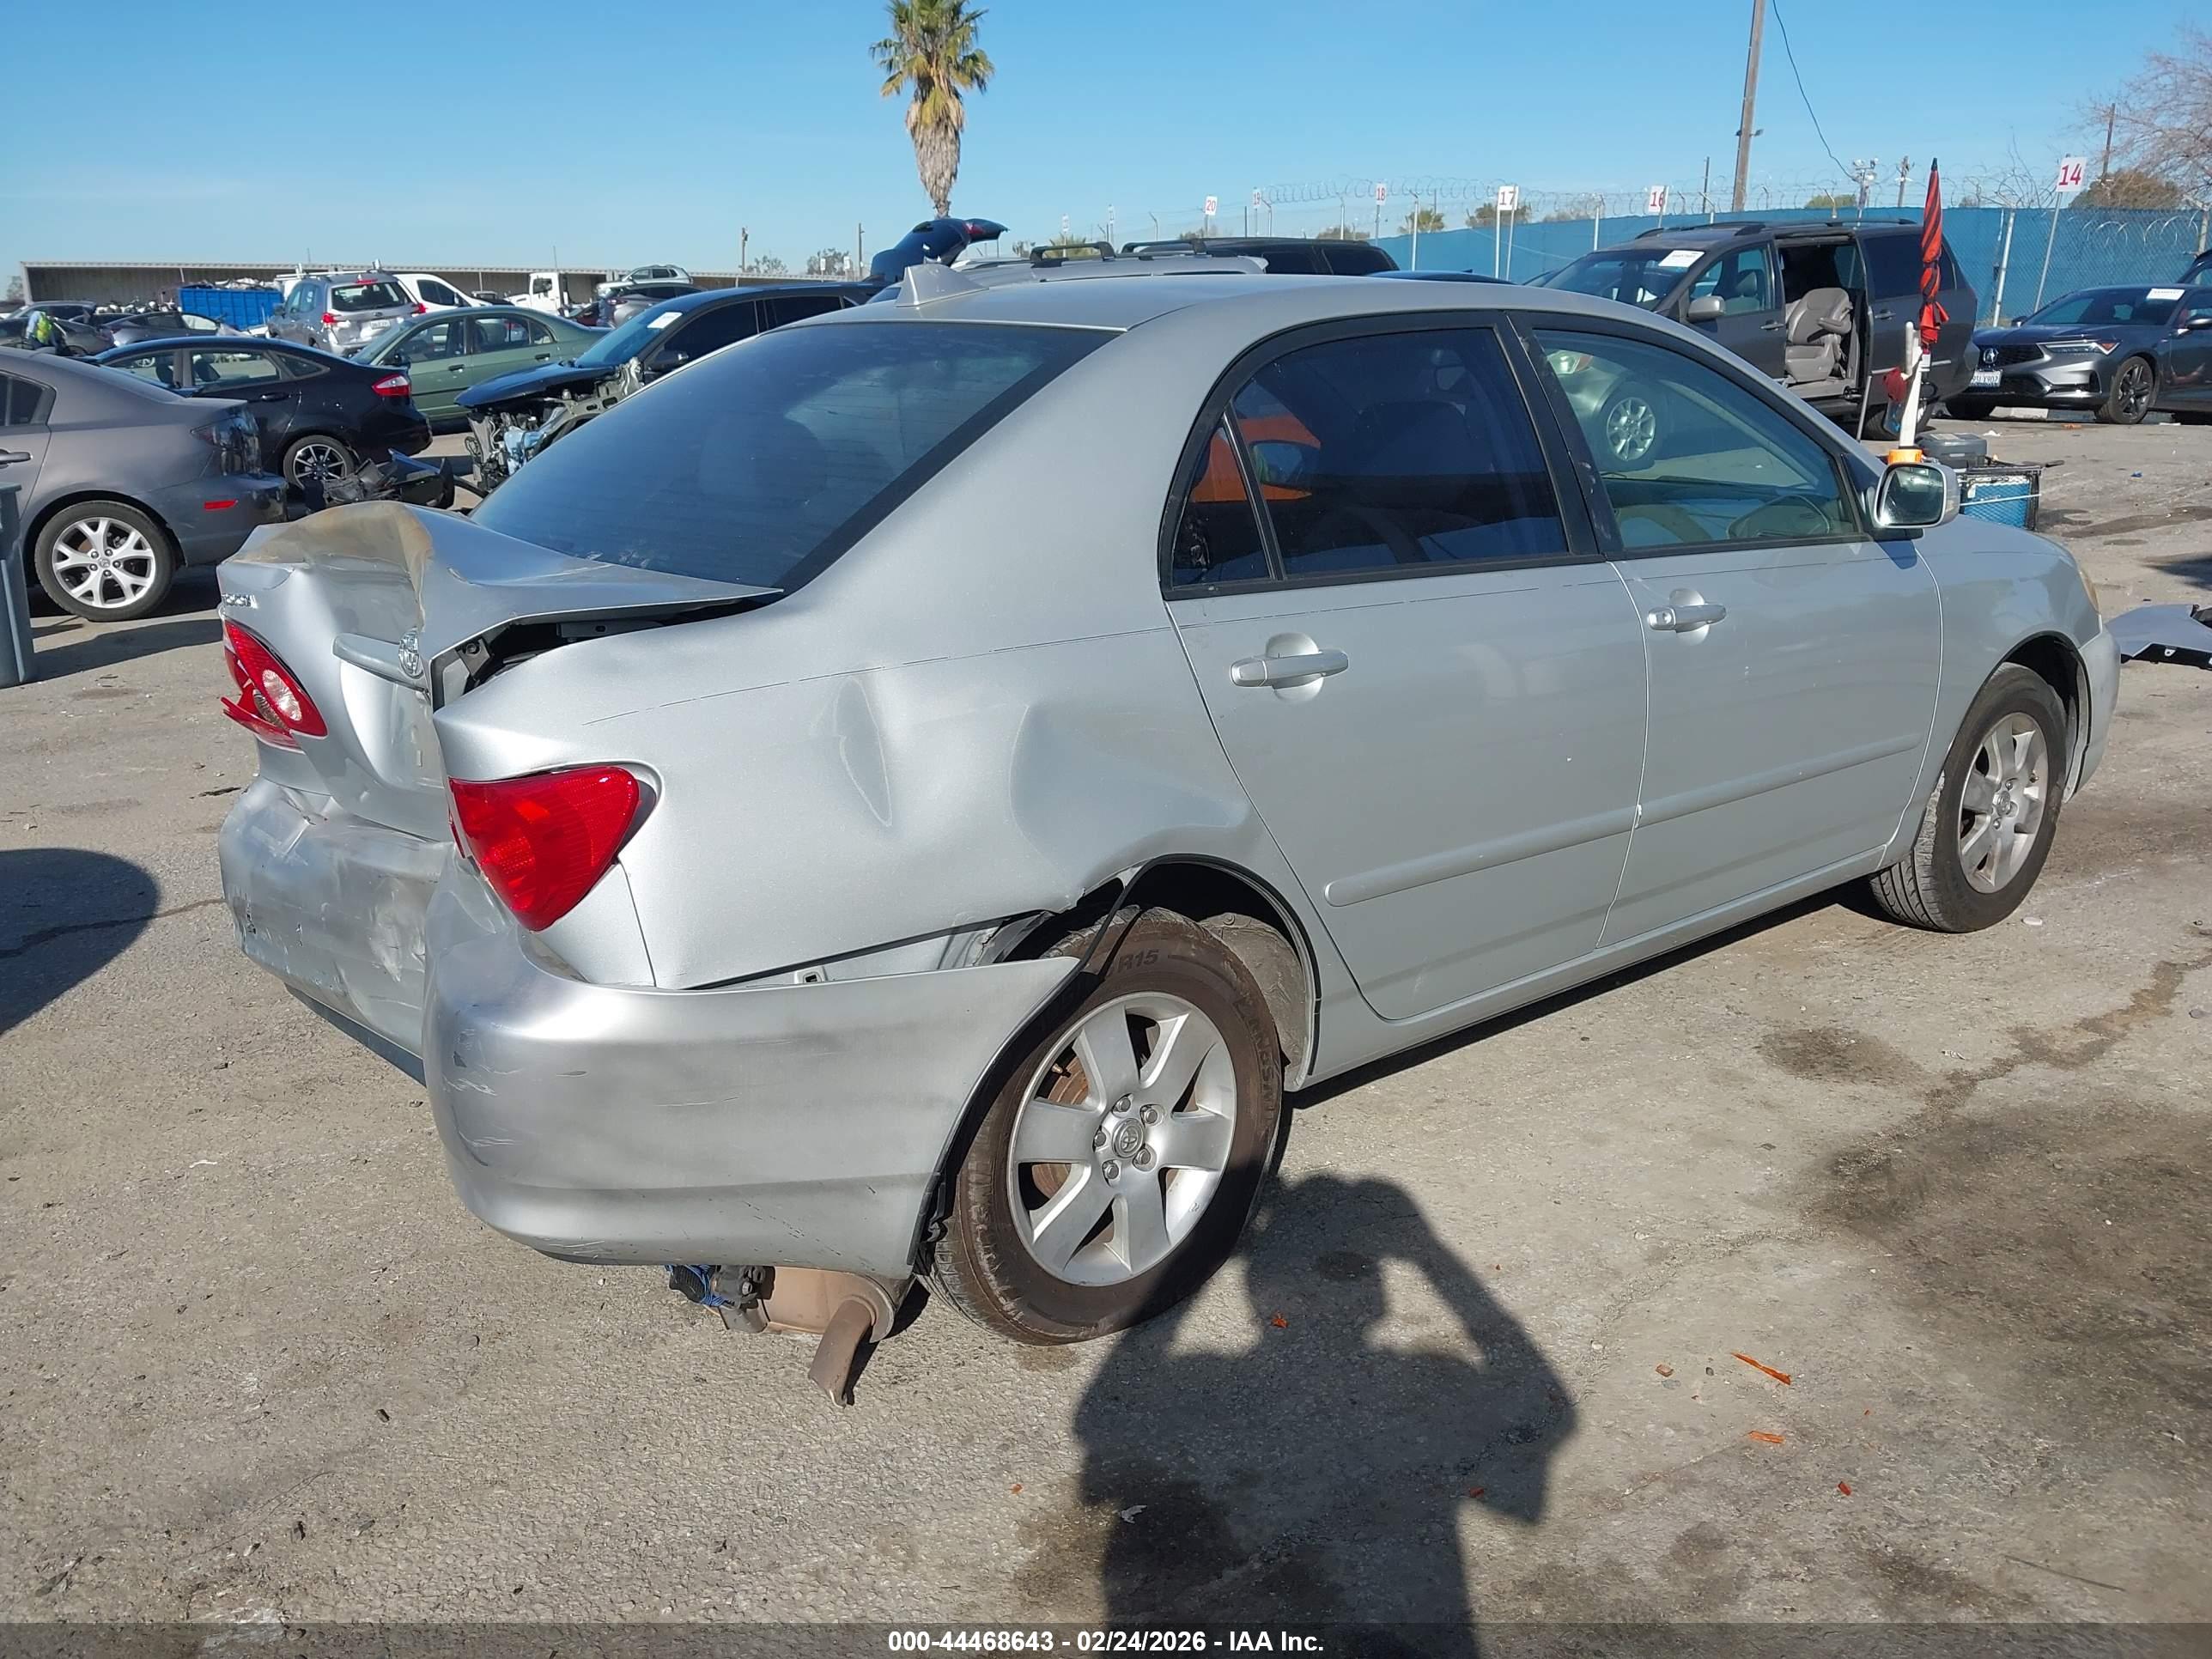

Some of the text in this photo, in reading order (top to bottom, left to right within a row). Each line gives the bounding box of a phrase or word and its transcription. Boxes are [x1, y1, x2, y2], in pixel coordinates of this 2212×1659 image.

[2058, 163, 2081, 185] 14
[1253, 191, 1261, 205] 19
[1376, 187, 1386, 201] 18
[1499, 191, 1514, 205] 17
[1206, 199, 1217, 211] 20
